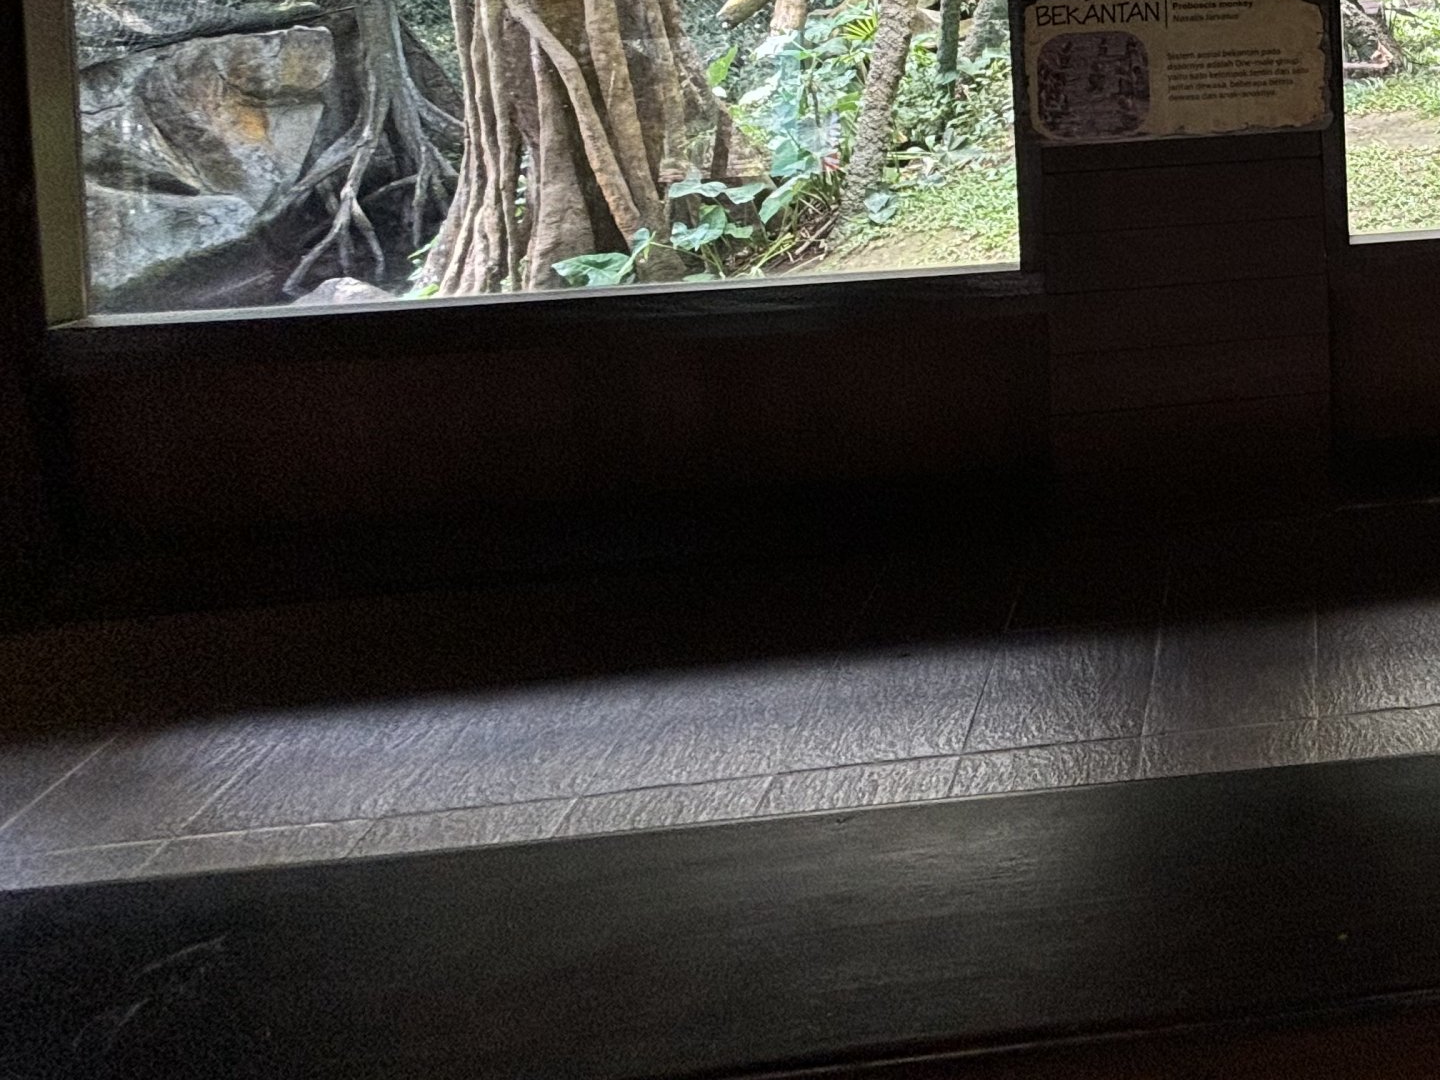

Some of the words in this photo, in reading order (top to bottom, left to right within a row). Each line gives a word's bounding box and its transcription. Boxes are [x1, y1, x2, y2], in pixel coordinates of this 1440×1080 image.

[1036, 1, 1160, 26] BEKANTAN
[1172, 1, 1216, 10] Proboscis
[1218, 0, 1254, 8] monkey
